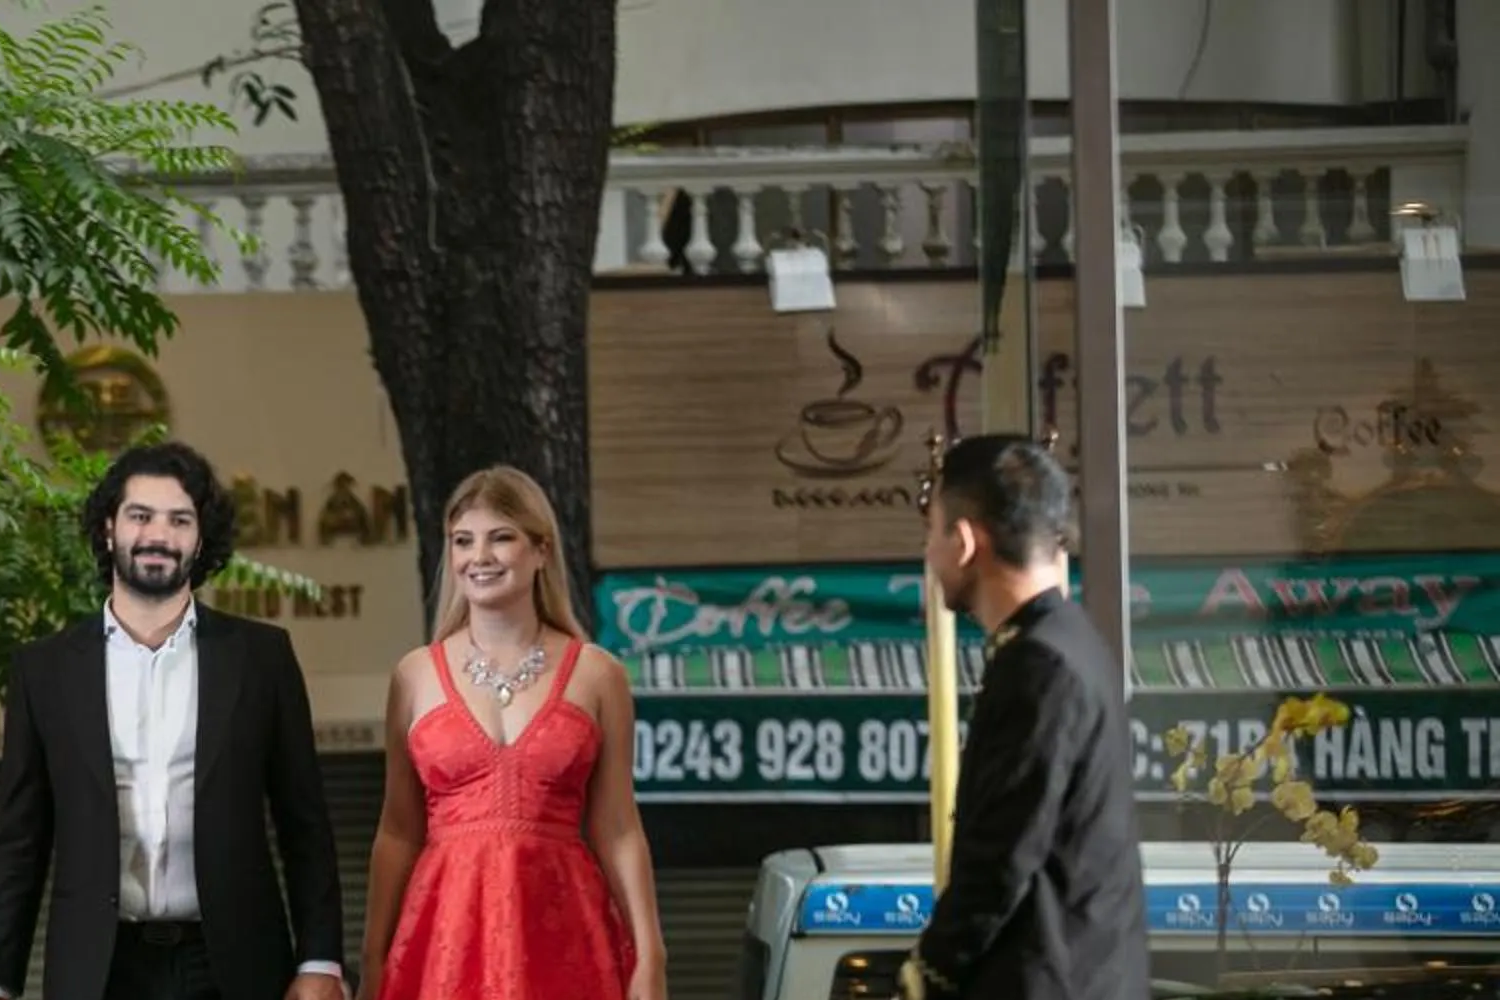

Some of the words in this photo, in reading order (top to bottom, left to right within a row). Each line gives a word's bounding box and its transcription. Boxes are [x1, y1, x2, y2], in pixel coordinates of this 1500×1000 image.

[1202, 566, 1480, 634] Away
[633, 719, 743, 782] 0243
[756, 718, 845, 782] 928
[1314, 705, 1446, 780] HÀNG
